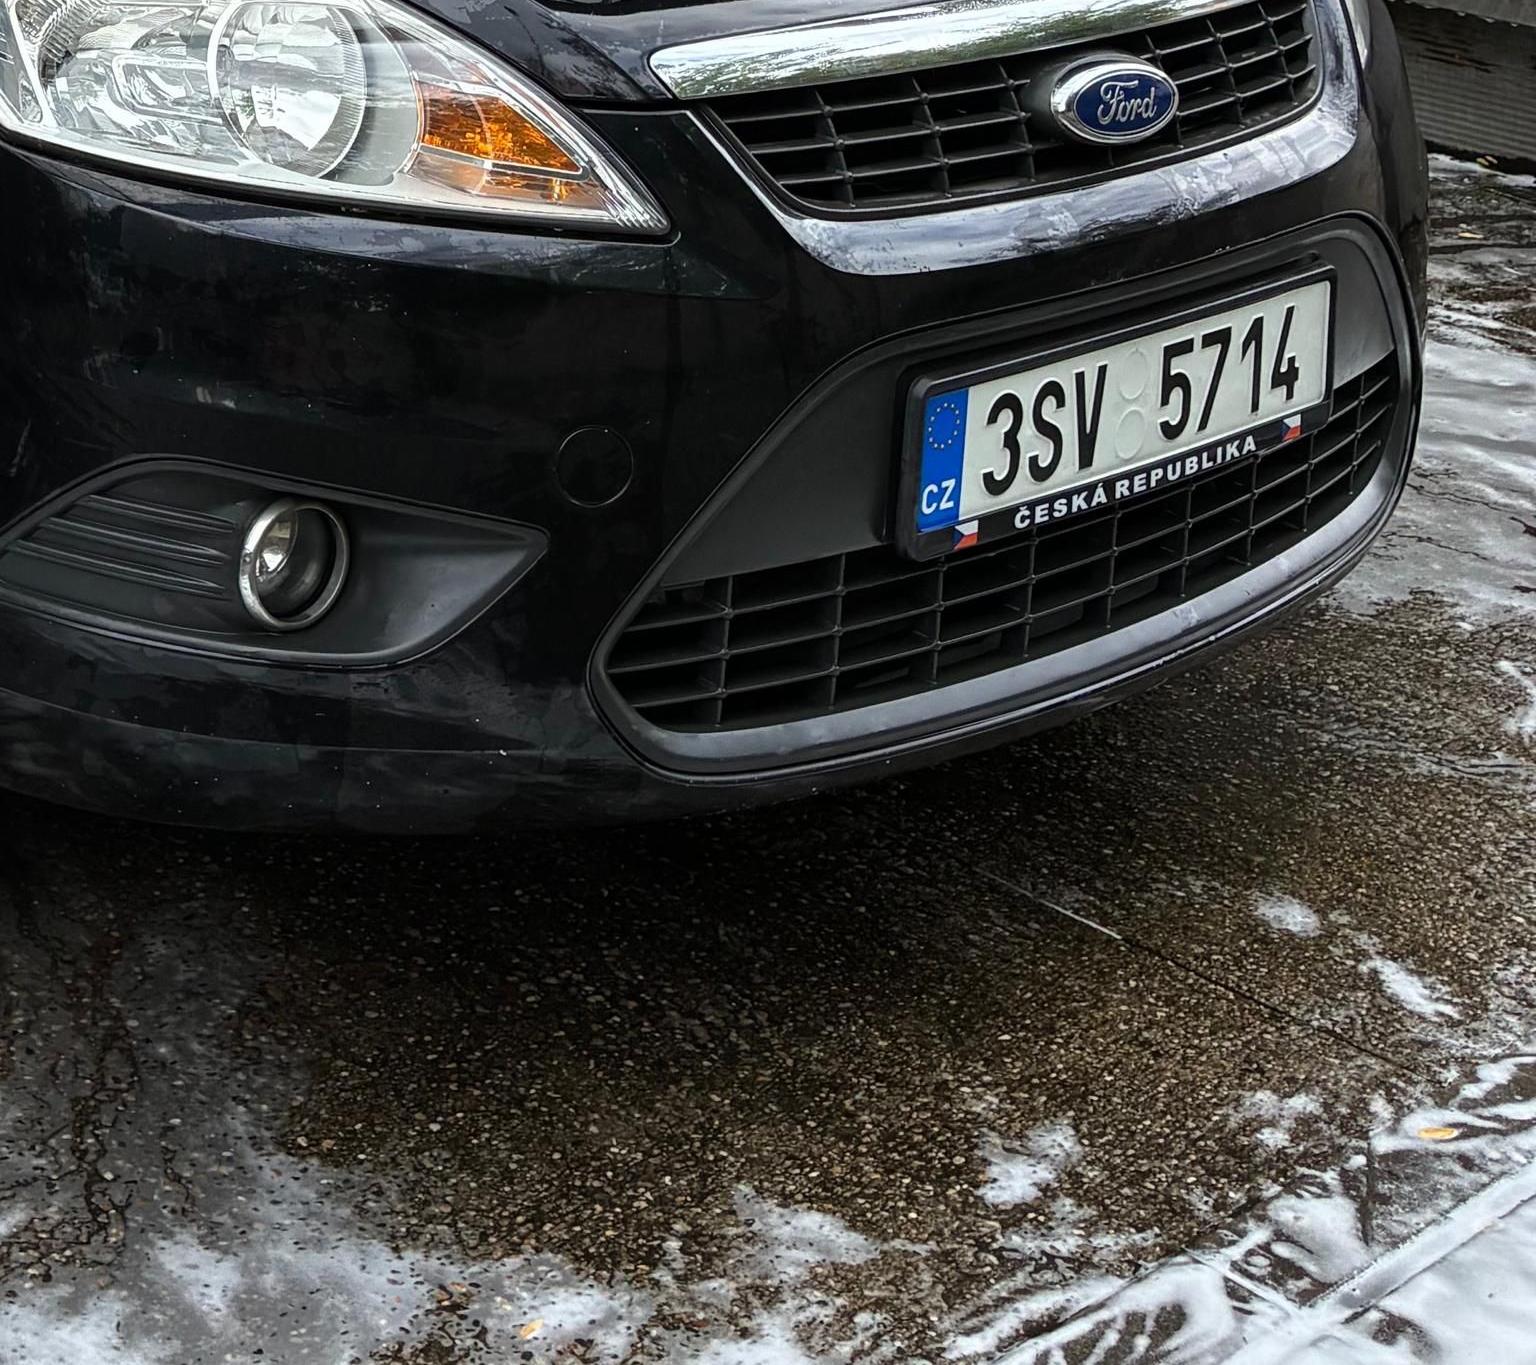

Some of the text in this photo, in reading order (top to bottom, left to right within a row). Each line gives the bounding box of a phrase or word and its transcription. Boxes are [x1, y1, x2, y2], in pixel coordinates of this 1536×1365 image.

[1096, 79, 1158, 126] Ford
[981, 304, 1301, 498] 3SV 5714
[920, 477, 957, 516] CZ
[1014, 434, 1258, 530] ČESKÁ REPUBLIKA
